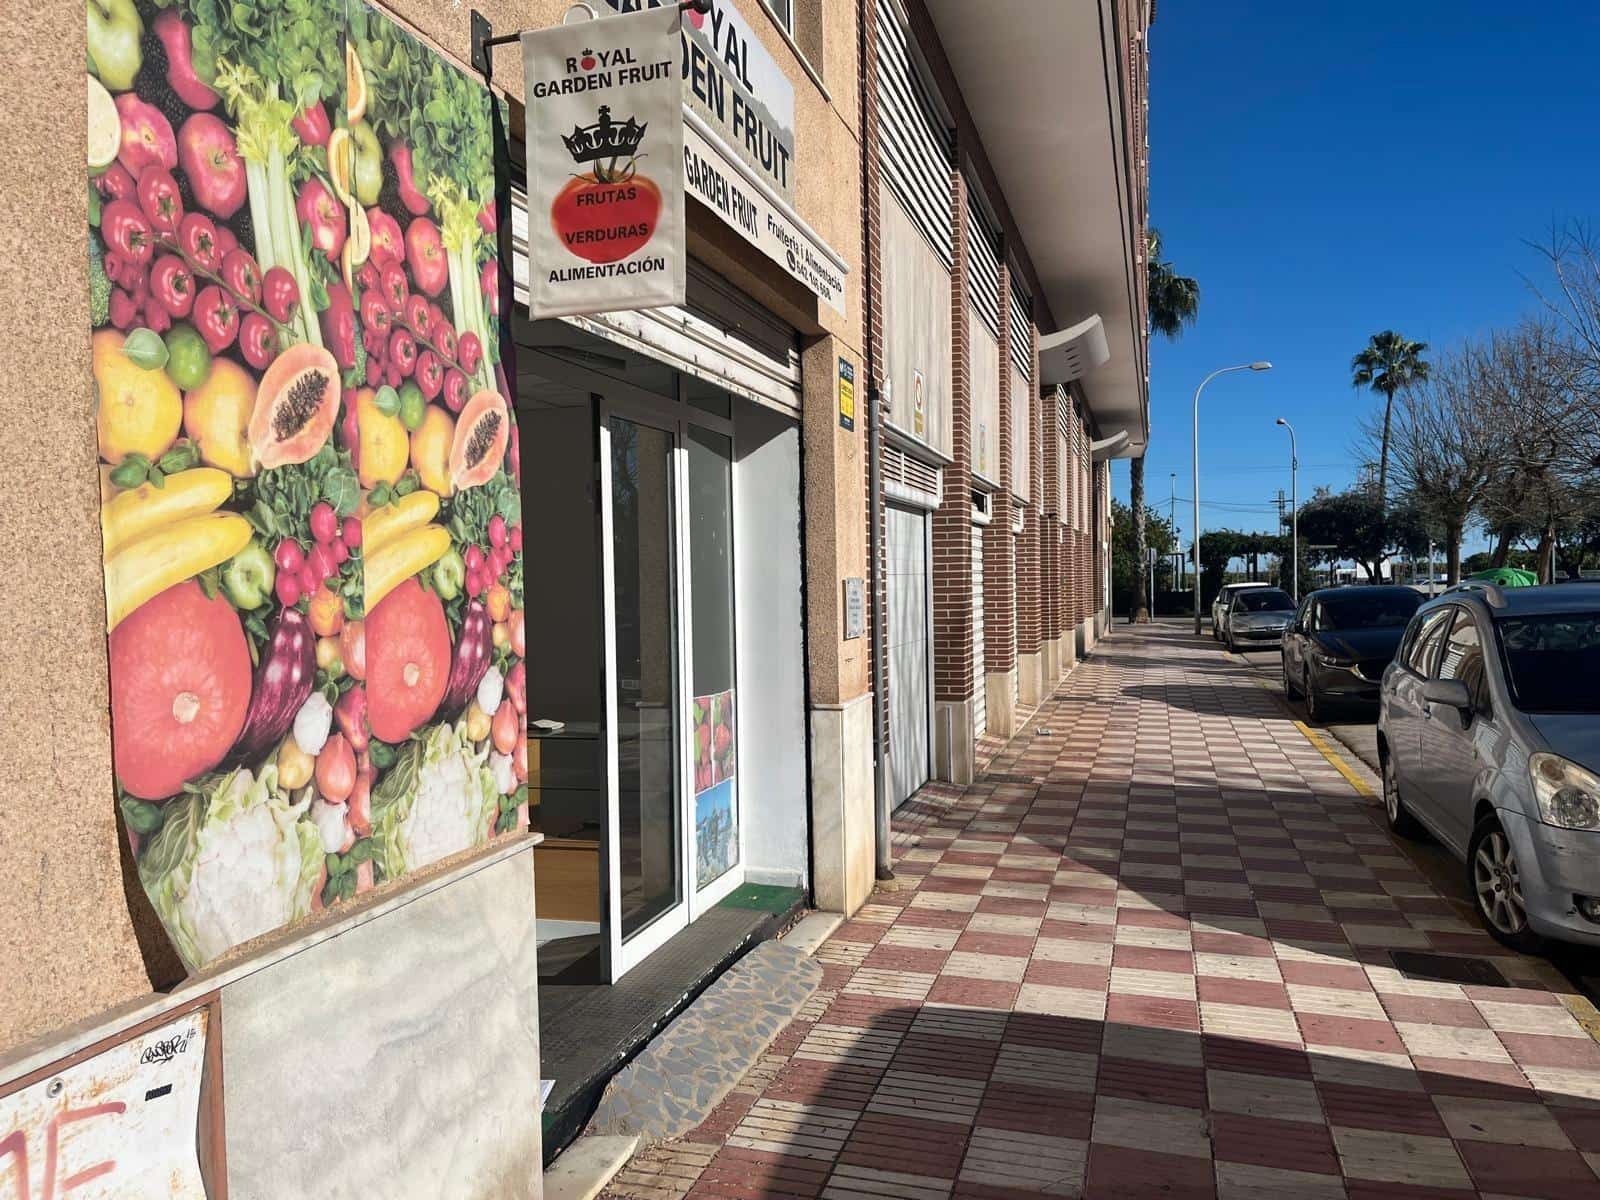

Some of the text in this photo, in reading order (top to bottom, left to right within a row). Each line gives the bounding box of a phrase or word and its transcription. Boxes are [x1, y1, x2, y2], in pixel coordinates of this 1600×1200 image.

[533, 61, 672, 98] GARDEN FRUIT
[732, 90, 790, 189] FRUIT
[576, 187, 637, 207] FRUTAS
[684, 145, 759, 239] GARDEN FRUIT
[565, 223, 649, 245] VERDURAS
[549, 256, 665, 283] ALIMENTACIÓN
